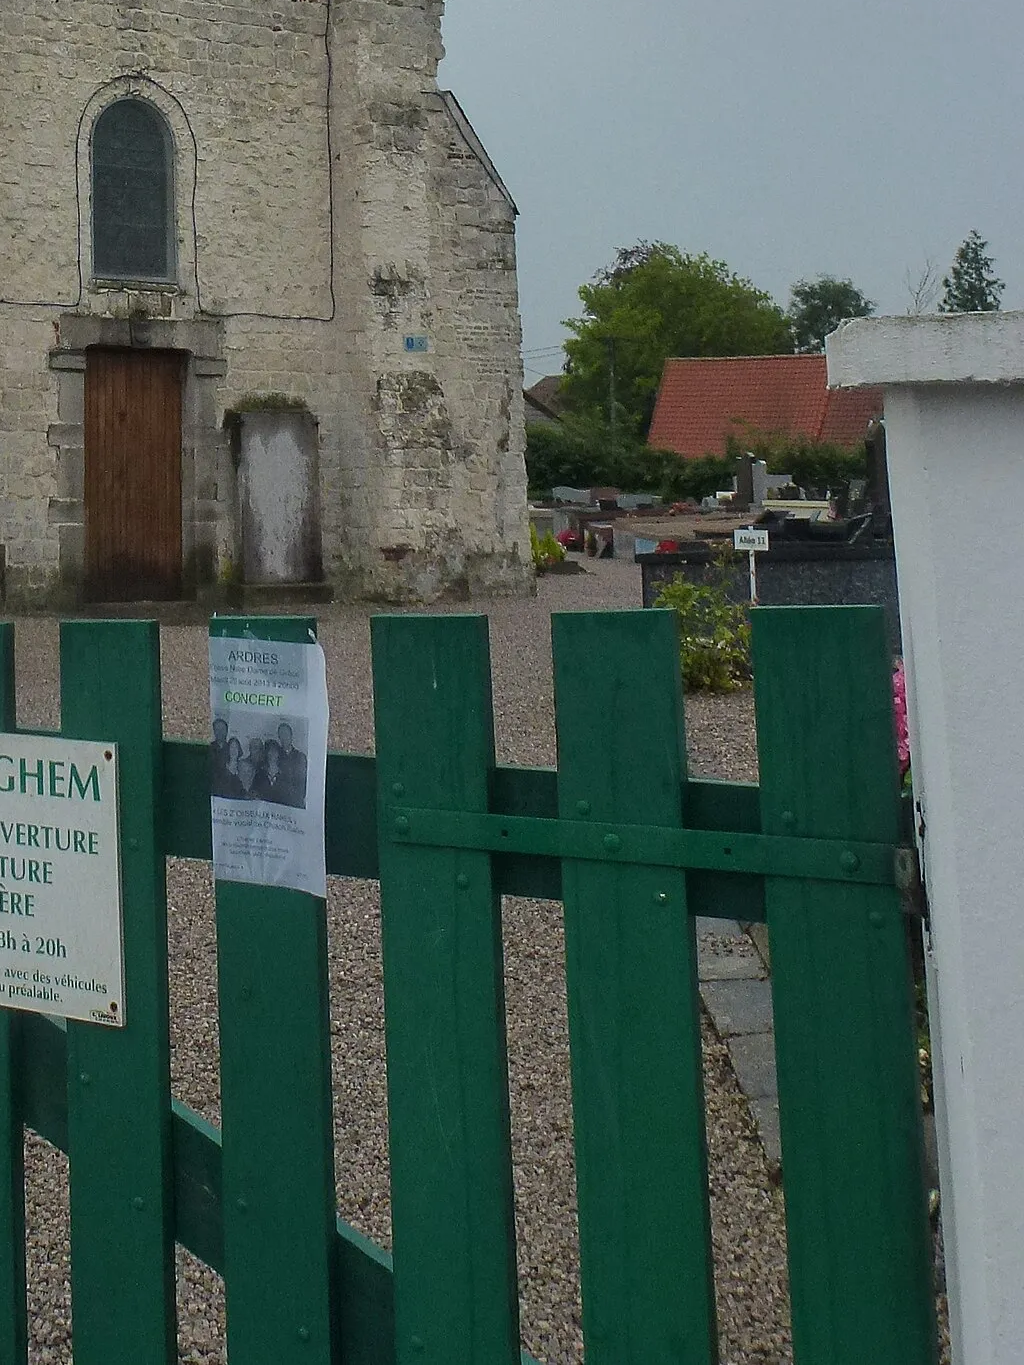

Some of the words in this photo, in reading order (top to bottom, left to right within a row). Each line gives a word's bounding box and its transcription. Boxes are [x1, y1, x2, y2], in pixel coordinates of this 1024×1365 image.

[228, 650, 279, 665] ARDRES
[225, 690, 283, 707] CONCERT
[21, 933, 31, 953] à
[35, 936, 67, 959] 20h
[4, 966, 29, 981] avec
[32, 969, 51, 985] des
[55, 973, 108, 994] véhicules
[8, 983, 64, 1003] préalable.
